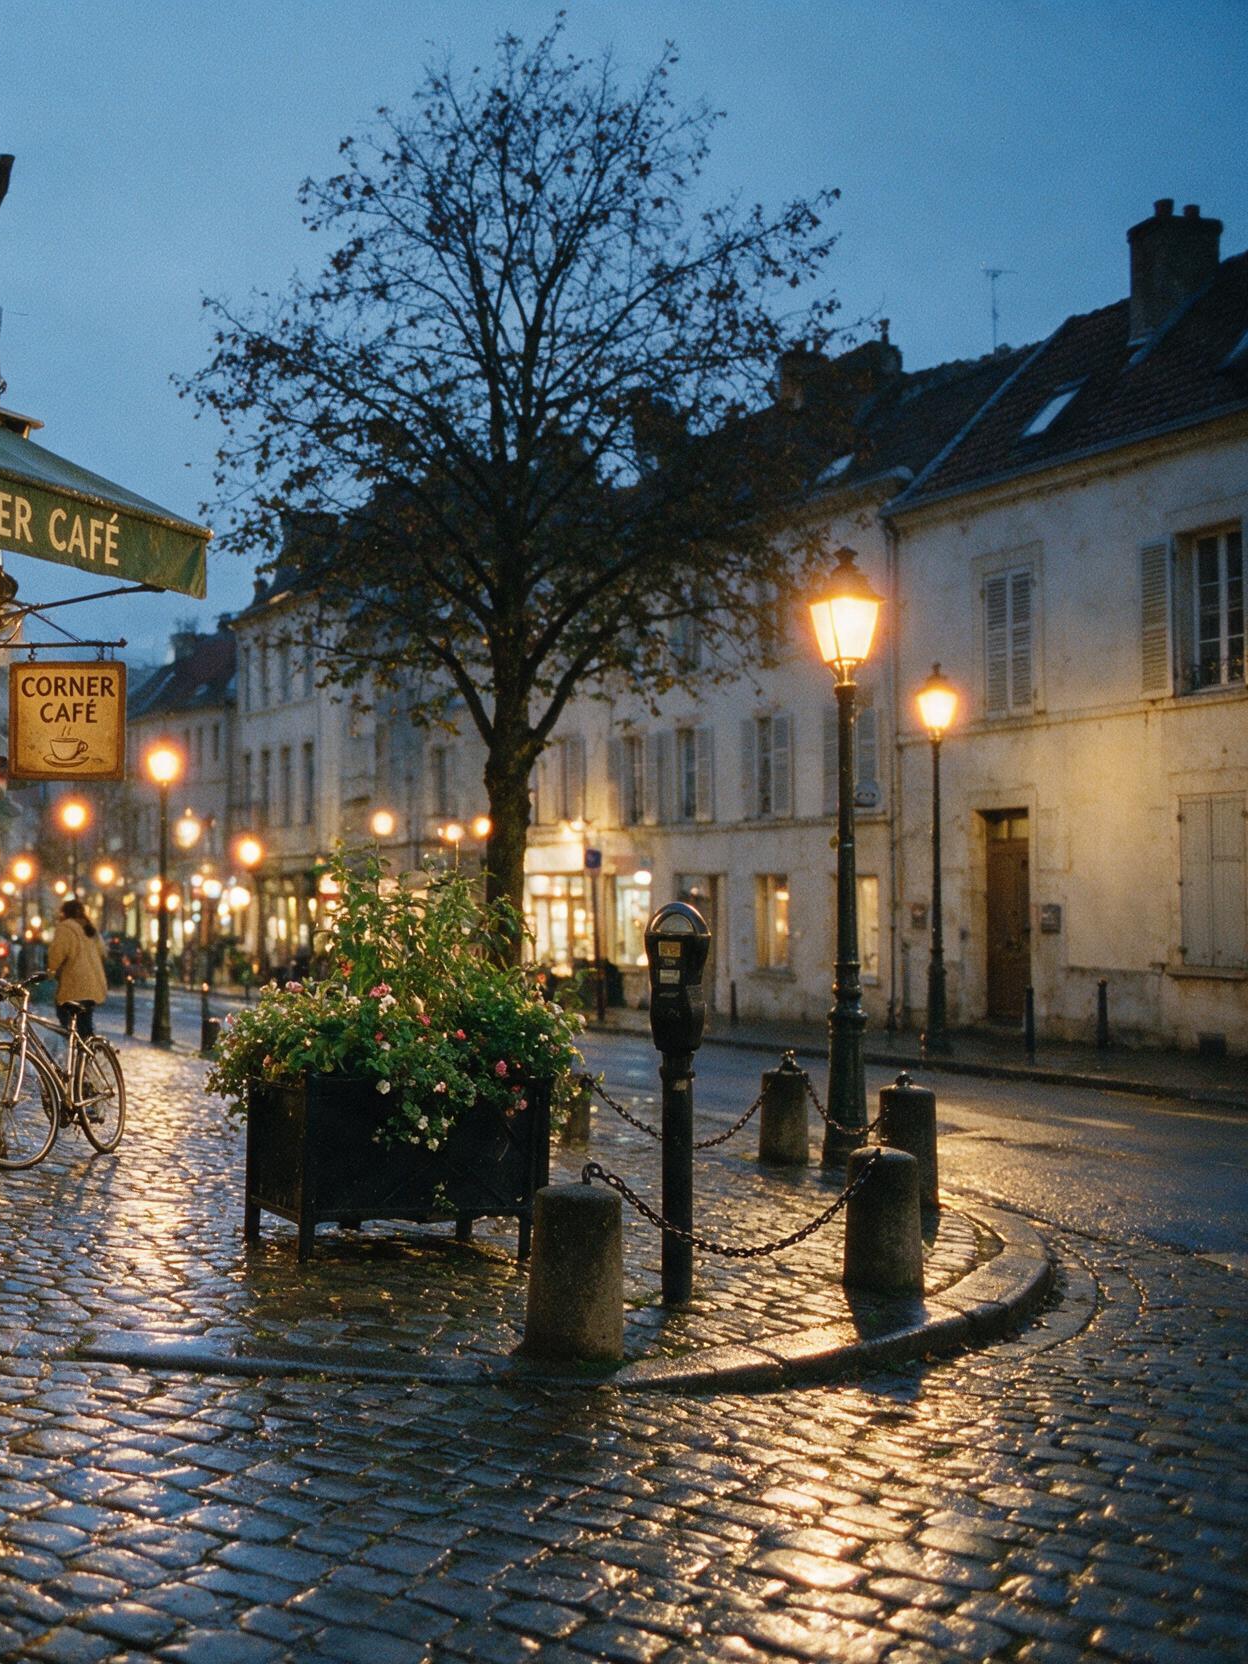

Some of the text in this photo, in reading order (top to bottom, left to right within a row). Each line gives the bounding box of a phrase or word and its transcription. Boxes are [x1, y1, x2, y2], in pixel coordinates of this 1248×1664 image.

[48, 508, 120, 566] CAFÉ
[21, 676, 115, 697] CORNER
[39, 699, 97, 723] CAFÉ
